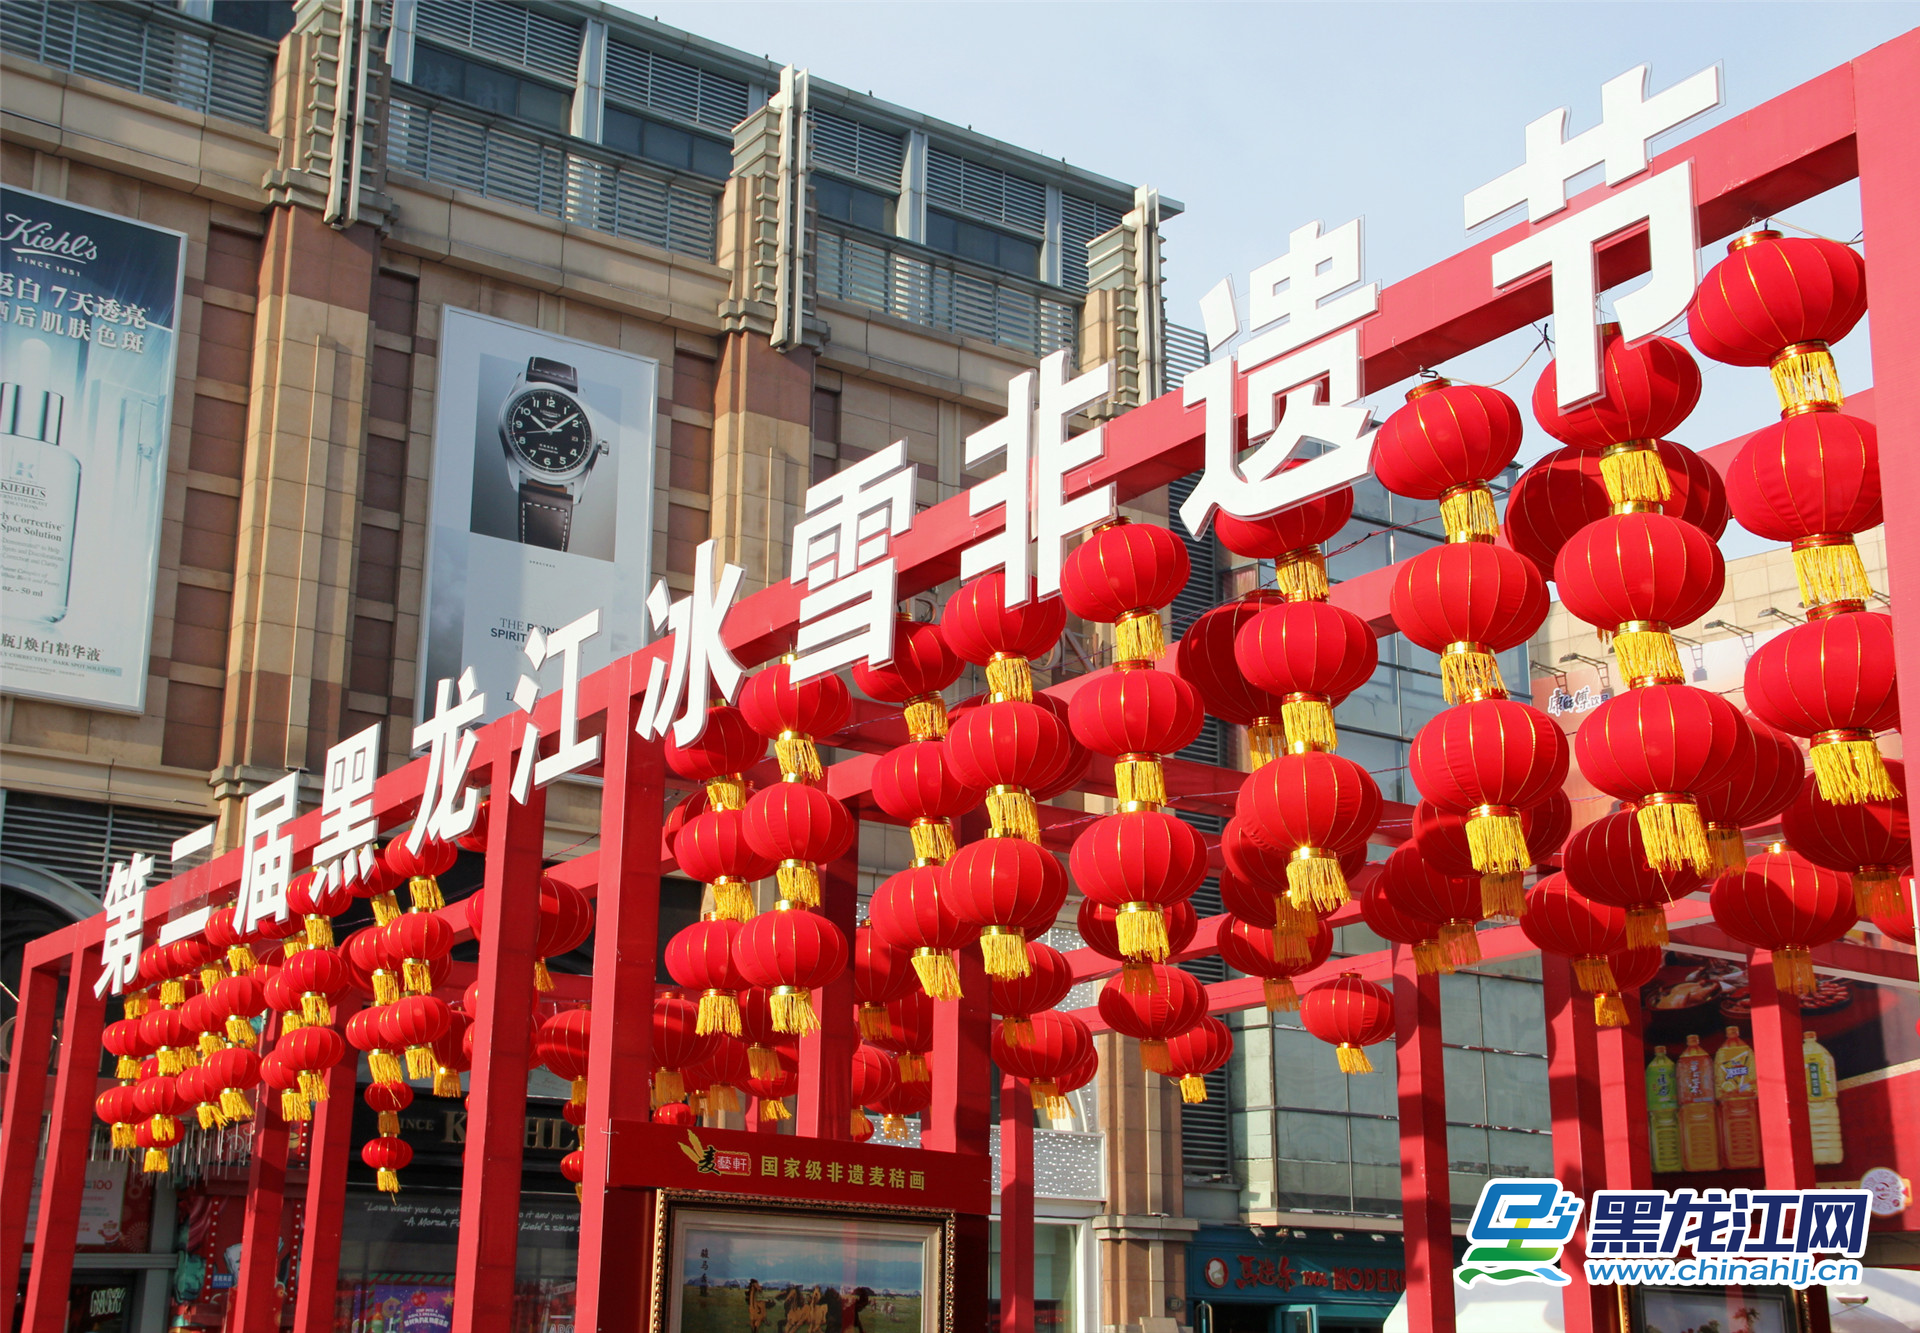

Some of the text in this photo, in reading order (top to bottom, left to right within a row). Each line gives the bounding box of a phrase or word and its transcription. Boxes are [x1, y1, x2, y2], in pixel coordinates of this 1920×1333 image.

[0, 213, 98, 260] Kiehl's
[16, 255, 51, 270] SINCE
[24, 527, 62, 542] Solution
[94, 63, 1721, 998] 第二届黑龙江冰雪非遗节
[500, 617, 524, 631] THE
[490, 628, 527, 643] SPIRIT
[761, 1155, 925, 1190] 国家级非遗麦秸画
